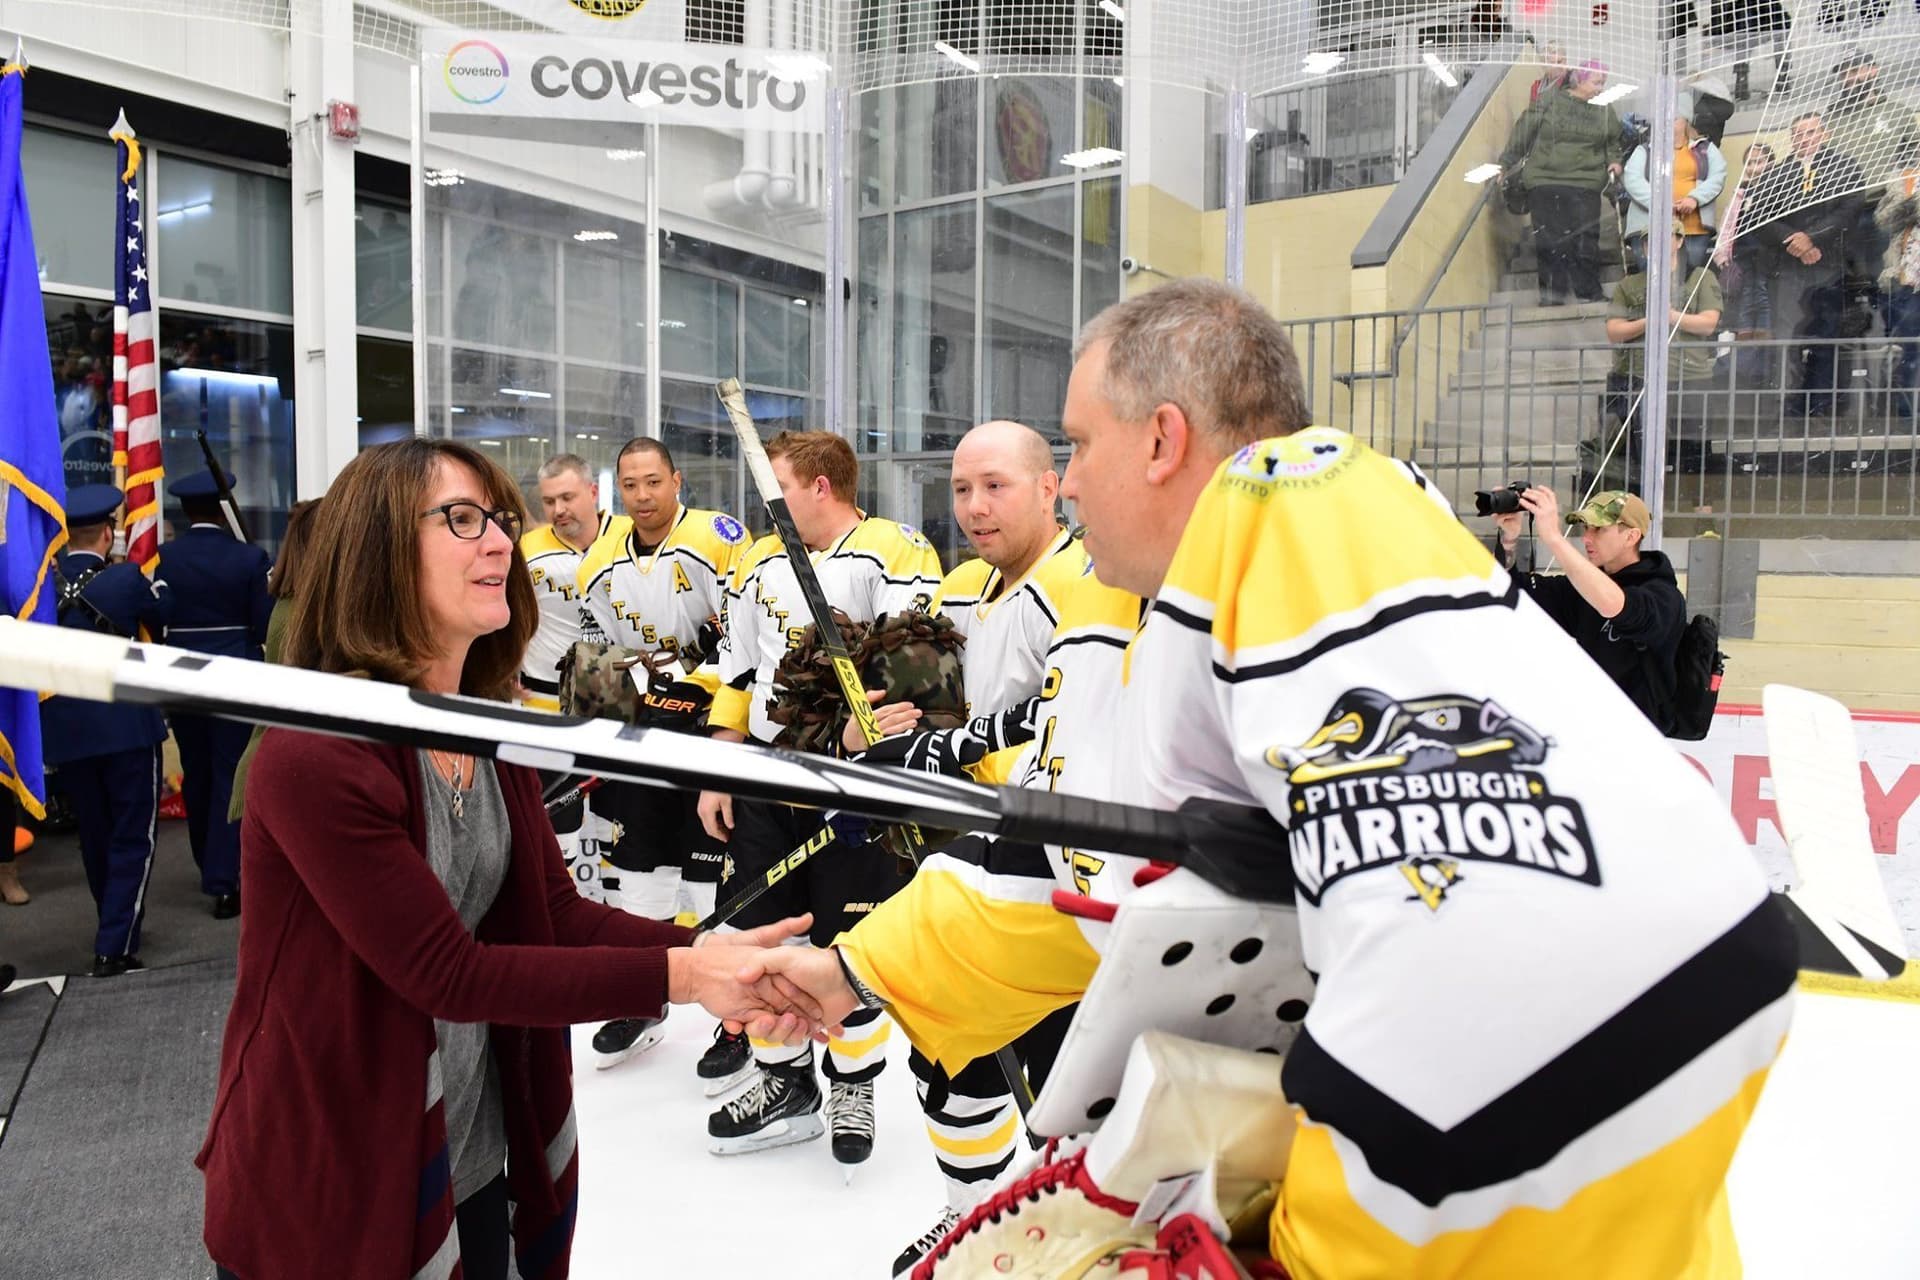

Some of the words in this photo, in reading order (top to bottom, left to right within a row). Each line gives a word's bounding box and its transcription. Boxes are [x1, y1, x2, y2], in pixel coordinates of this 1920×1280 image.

[449, 66, 502, 77] covestro
[531, 55, 806, 112] covestro
[673, 560, 693, 594] A
[755, 577, 806, 648] ITTS
[1304, 772, 1531, 814] PITTSBURGH
[1289, 801, 1588, 897] WARRIORS
